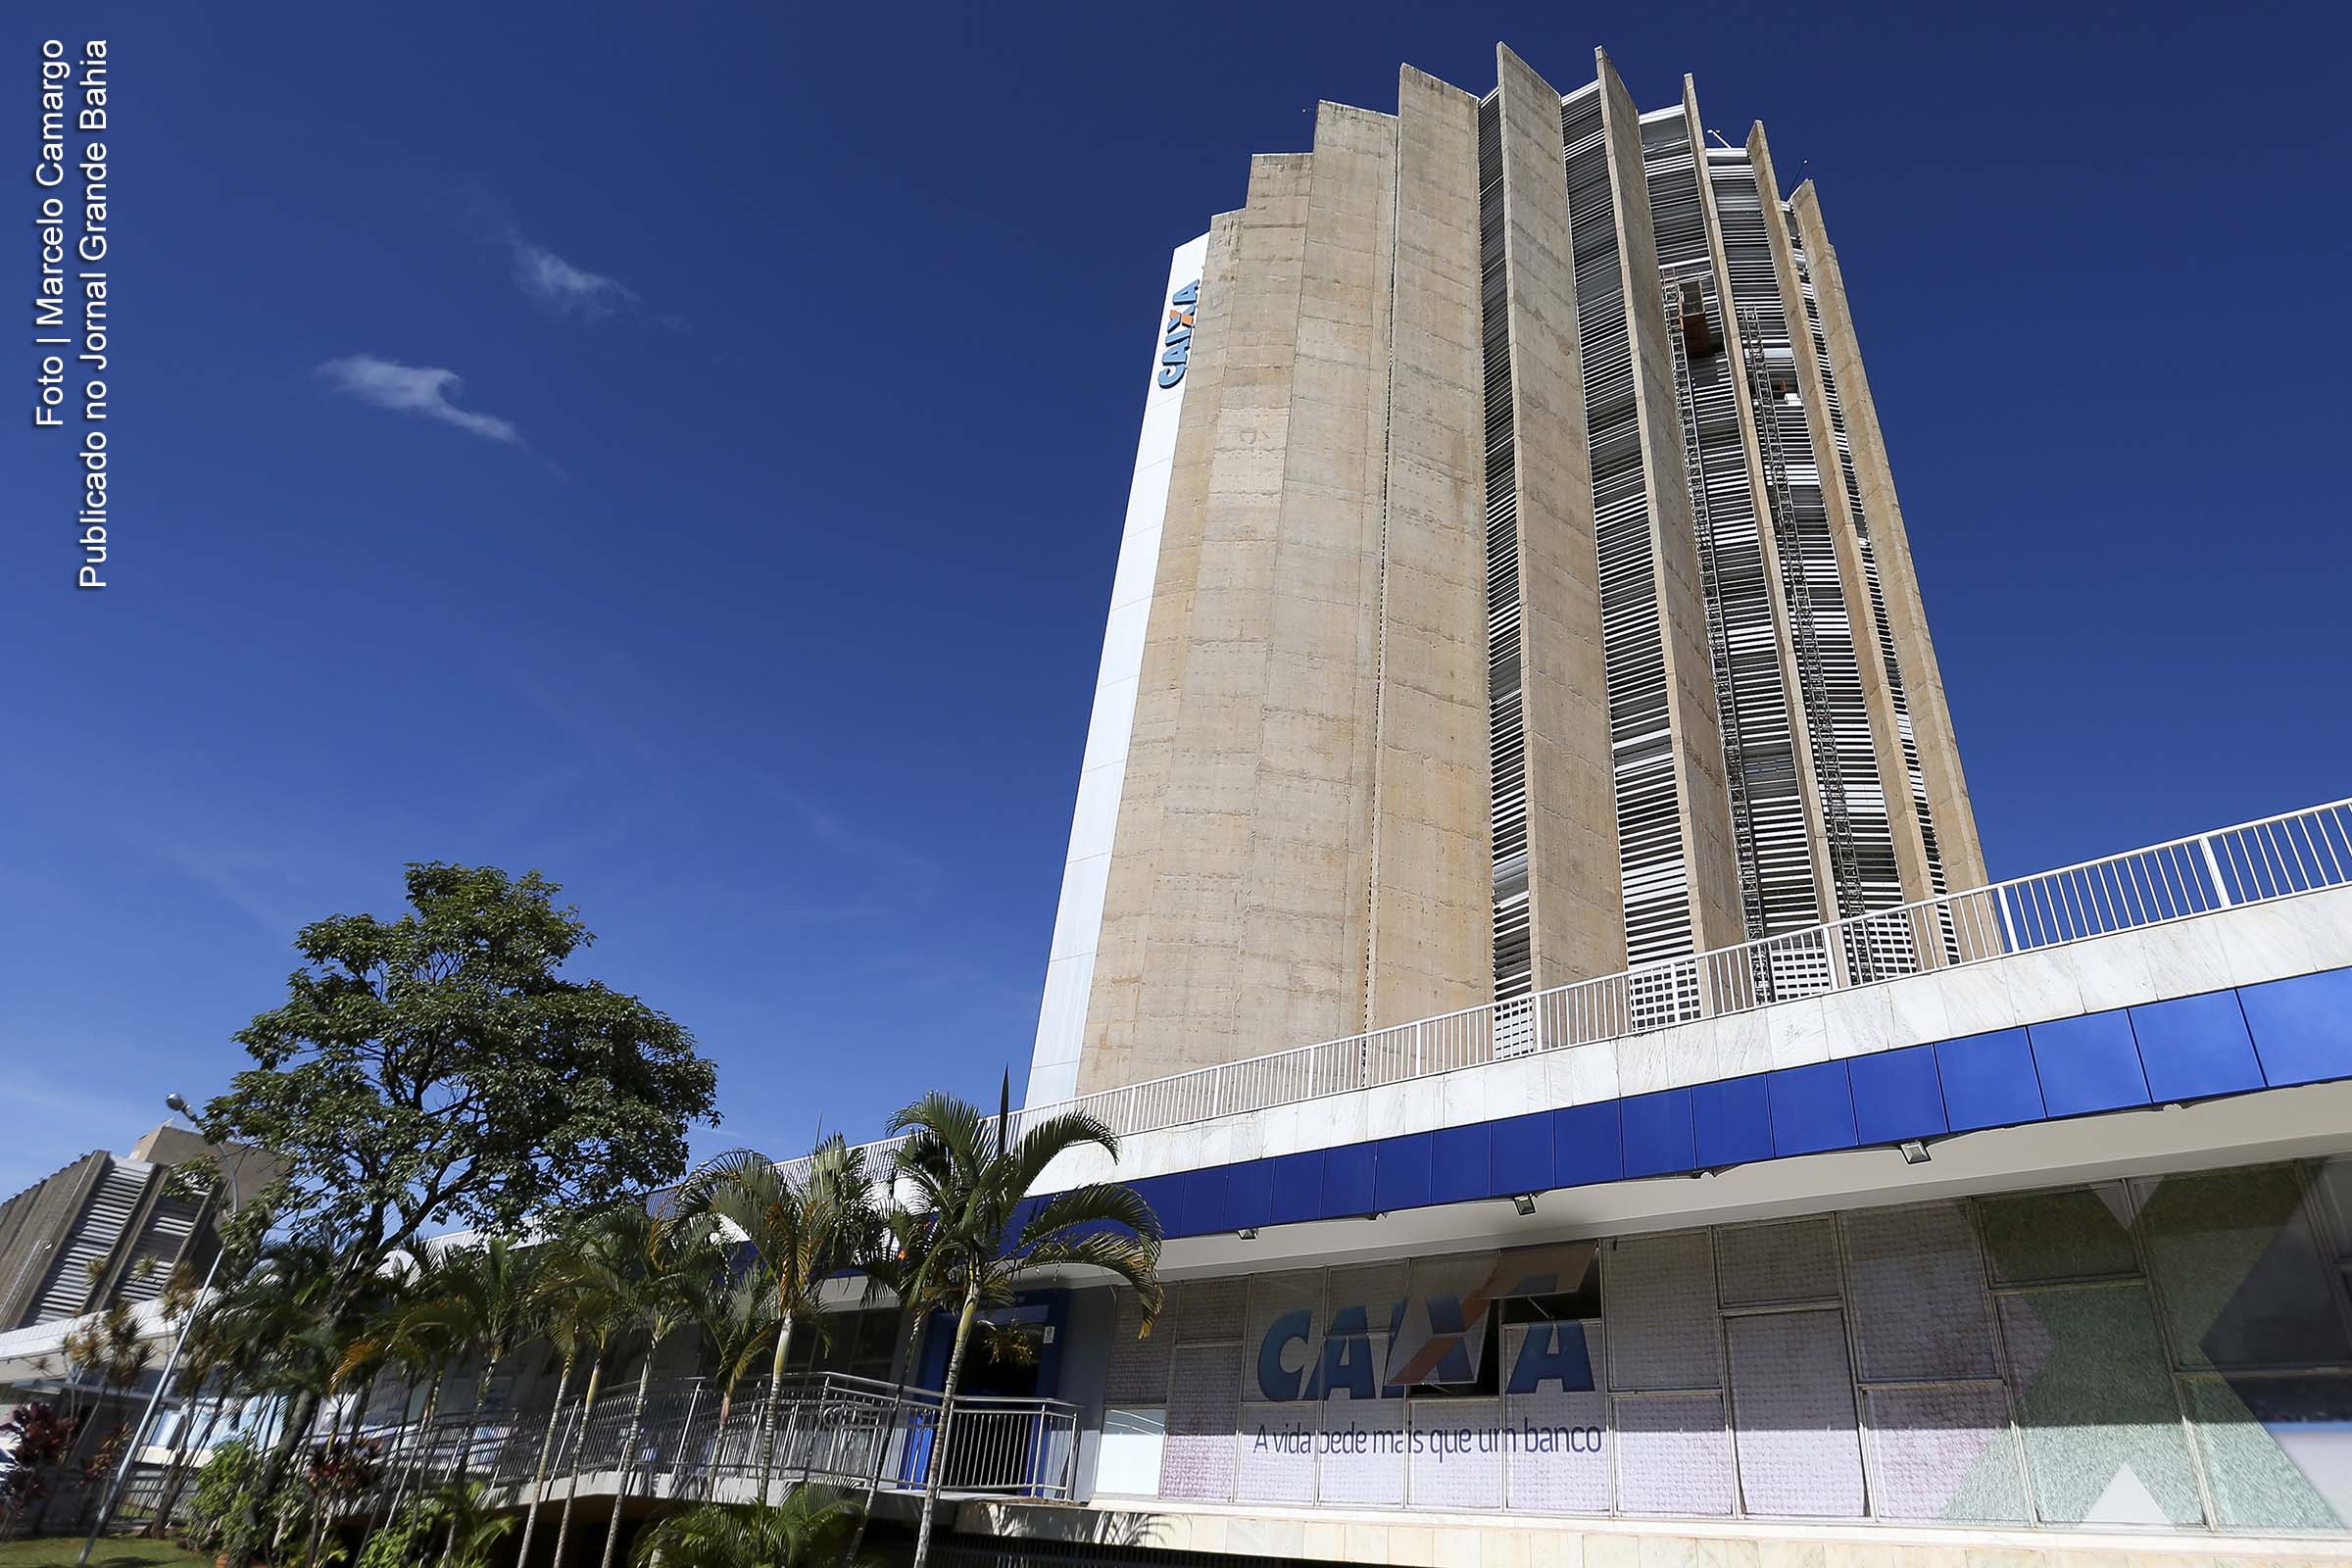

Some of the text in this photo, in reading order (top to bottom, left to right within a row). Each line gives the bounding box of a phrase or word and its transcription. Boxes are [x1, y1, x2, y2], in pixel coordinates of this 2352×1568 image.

[1158, 279, 1200, 389] CAIXA
[1252, 1424, 1269, 1454] A
[1272, 1421, 1311, 1454] vida
[1373, 1421, 1424, 1454] mais
[1430, 1428, 1472, 1463] que
[1479, 1426, 1516, 1453] um
[1524, 1417, 1602, 1453] banco
